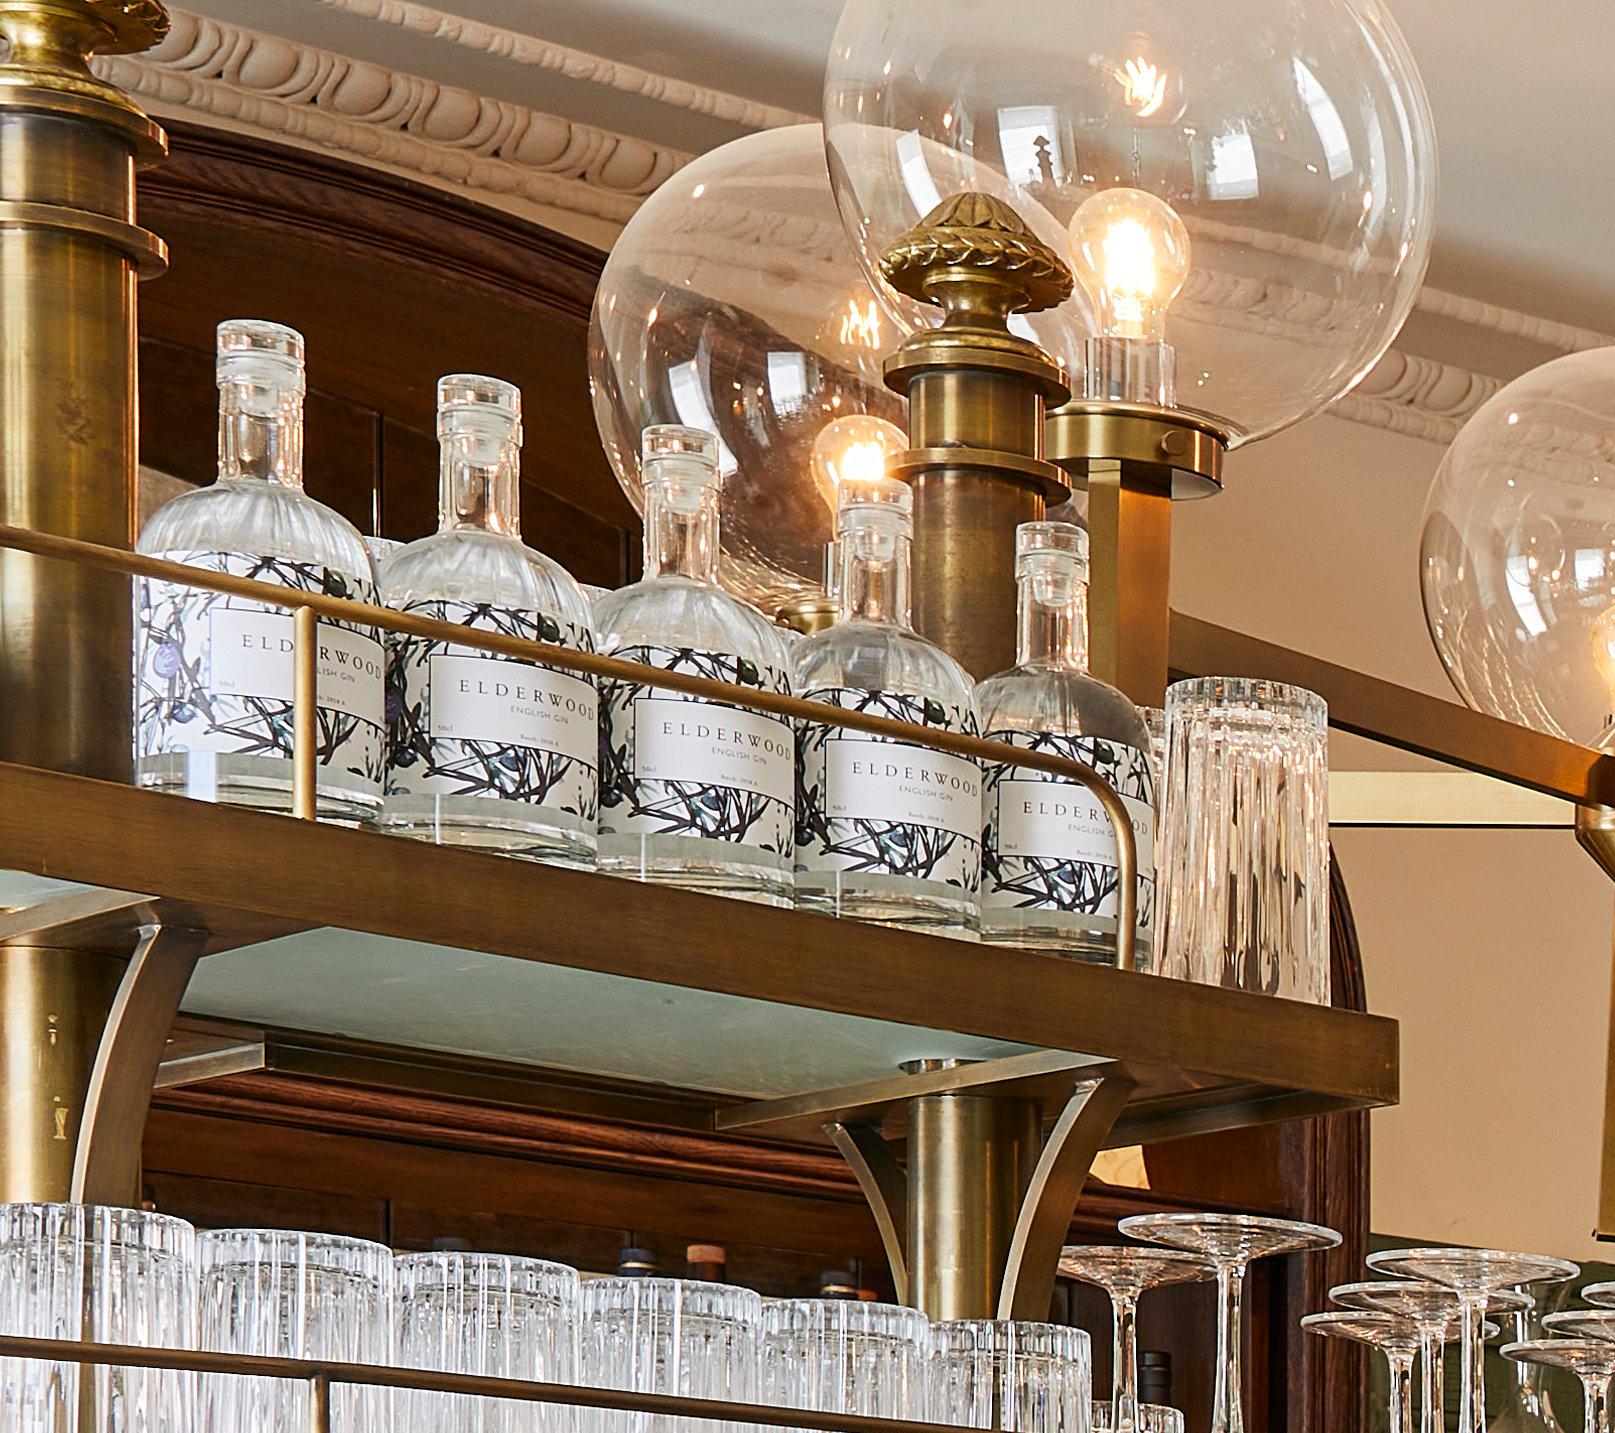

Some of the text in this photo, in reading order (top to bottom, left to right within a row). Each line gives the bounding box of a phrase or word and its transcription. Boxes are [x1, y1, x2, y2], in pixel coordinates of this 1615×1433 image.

[242, 634, 381, 679] ELDRWOOD
[460, 679, 594, 721] ELDERWOOD
[510, 705, 569, 725] ENGLISH GIN
[663, 722, 790, 760] ELDERWOOD
[712, 746, 750, 760] ENGLISH
[853, 761, 978, 797] ELDERWOOD
[899, 784, 937, 798] ENGLISH
[1024, 801, 1148, 835] ELDEROD
[1068, 823, 1105, 836] ENGLISH
